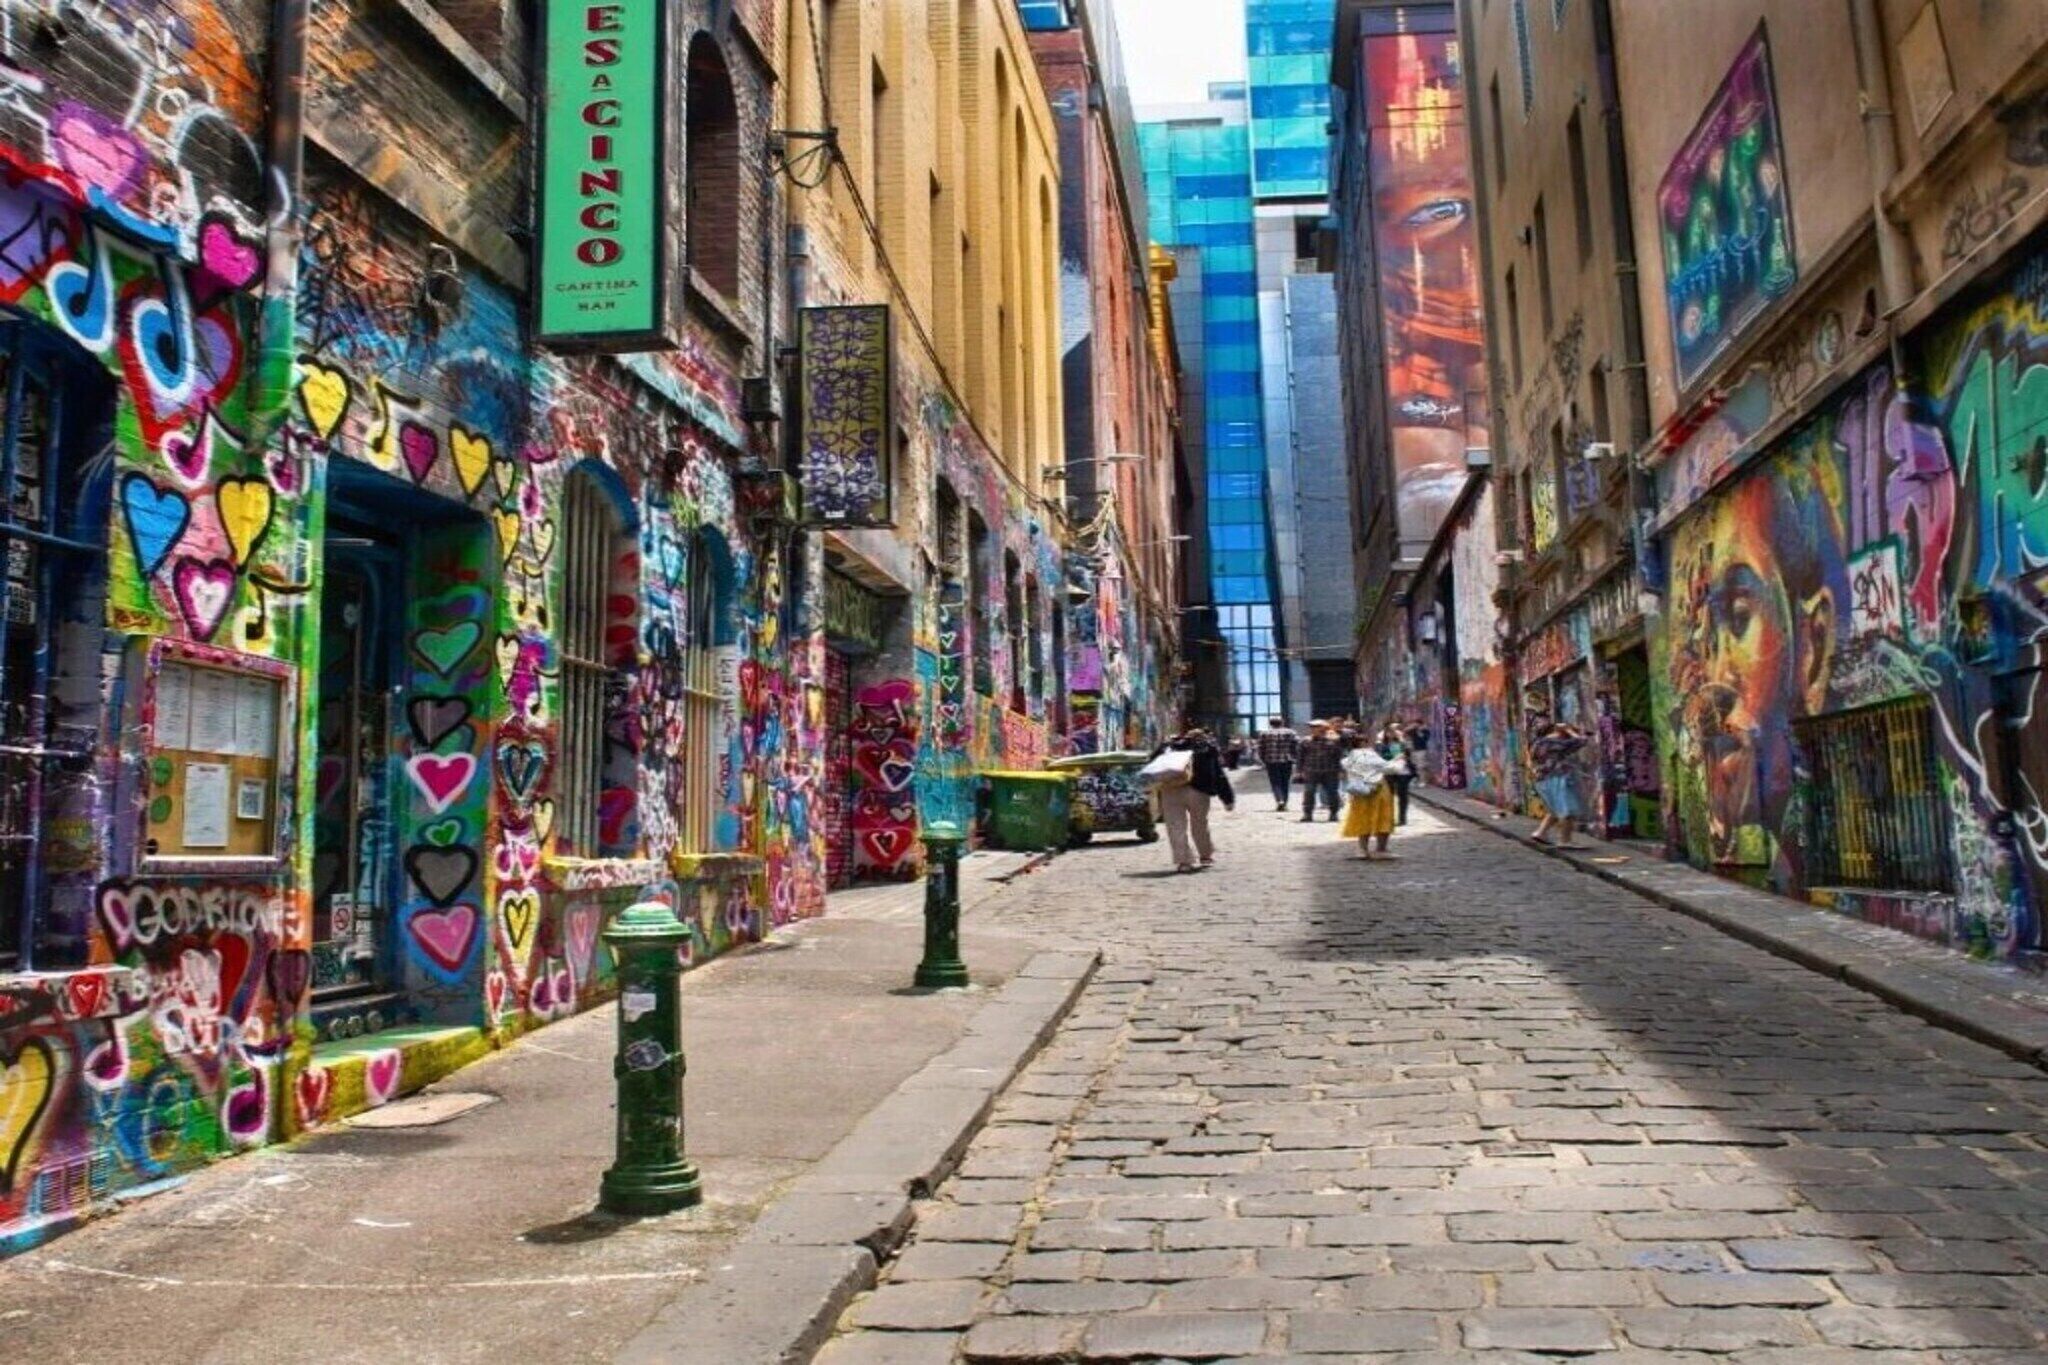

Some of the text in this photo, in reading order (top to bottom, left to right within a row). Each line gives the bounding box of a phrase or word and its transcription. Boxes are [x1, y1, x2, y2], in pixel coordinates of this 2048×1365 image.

[555, 279, 639, 293] CANTINA
[577, 301, 616, 311] BAR
[132, 886, 200, 944] GOD
